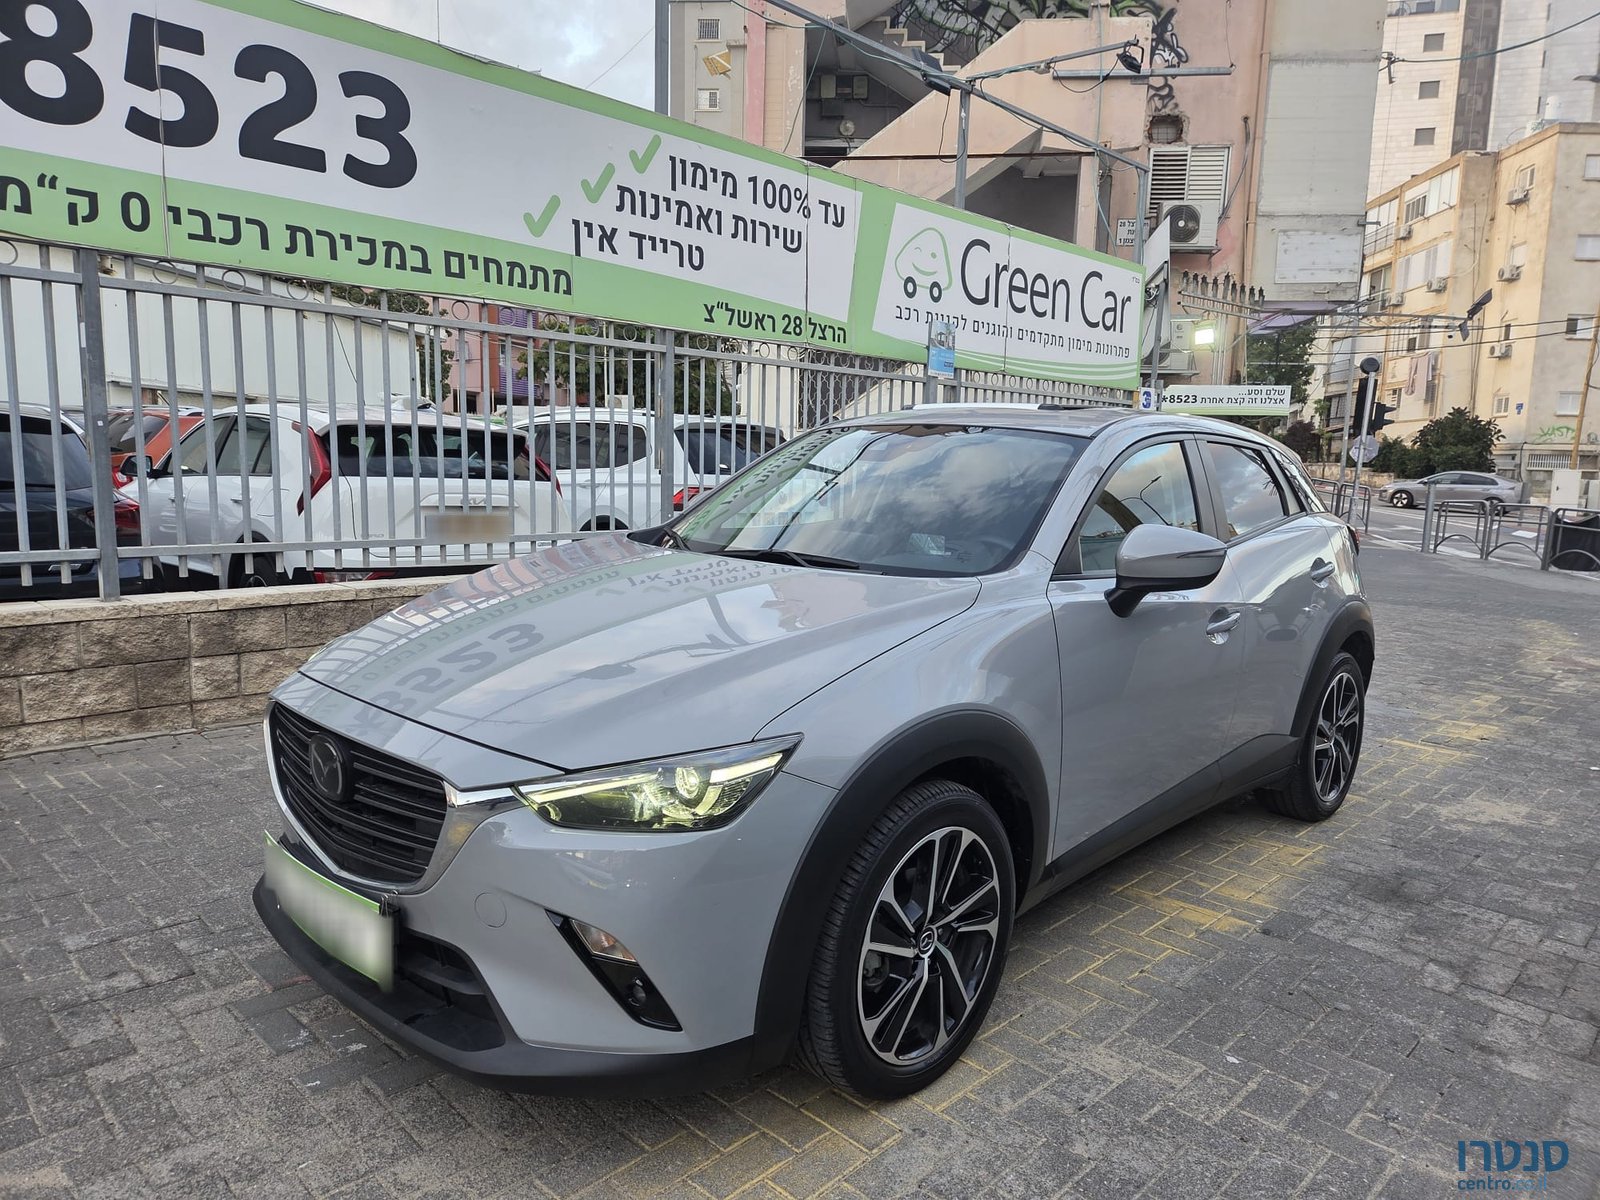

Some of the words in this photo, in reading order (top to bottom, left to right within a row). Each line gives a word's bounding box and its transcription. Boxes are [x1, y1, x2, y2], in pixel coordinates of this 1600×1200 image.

[0, 0, 418, 189] 8523
[668, 155, 738, 199] מימון
[120, 191, 151, 232] 0
[615, 184, 723, 236] ואמינות
[747, 175, 811, 219] 100%
[167, 204, 270, 251] רכבי
[818, 199, 845, 228] עד
[571, 218, 619, 256] אין
[731, 213, 802, 253] שירות
[285, 223, 432, 275] במכירת
[628, 230, 705, 271] טרייד
[444, 249, 573, 296] מתמחים
[960, 238, 1071, 323] Green
[1080, 270, 1132, 334] Car
[781, 313, 803, 337] 28
[895, 305, 919, 323] רכב
[808, 317, 847, 344] הרצל
[972, 320, 1013, 339] והוגנים
[1017, 328, 1064, 348] מתקדמים
[1068, 337, 1092, 352] מימון
[1095, 342, 1130, 359] פתרונות
[1200, 396, 1224, 404] אחרת
[1226, 396, 1245, 405] קצת
[1247, 396, 1258, 404] זה
[1260, 396, 1285, 404] אצלנו
[1265, 388, 1286, 396] שלם
